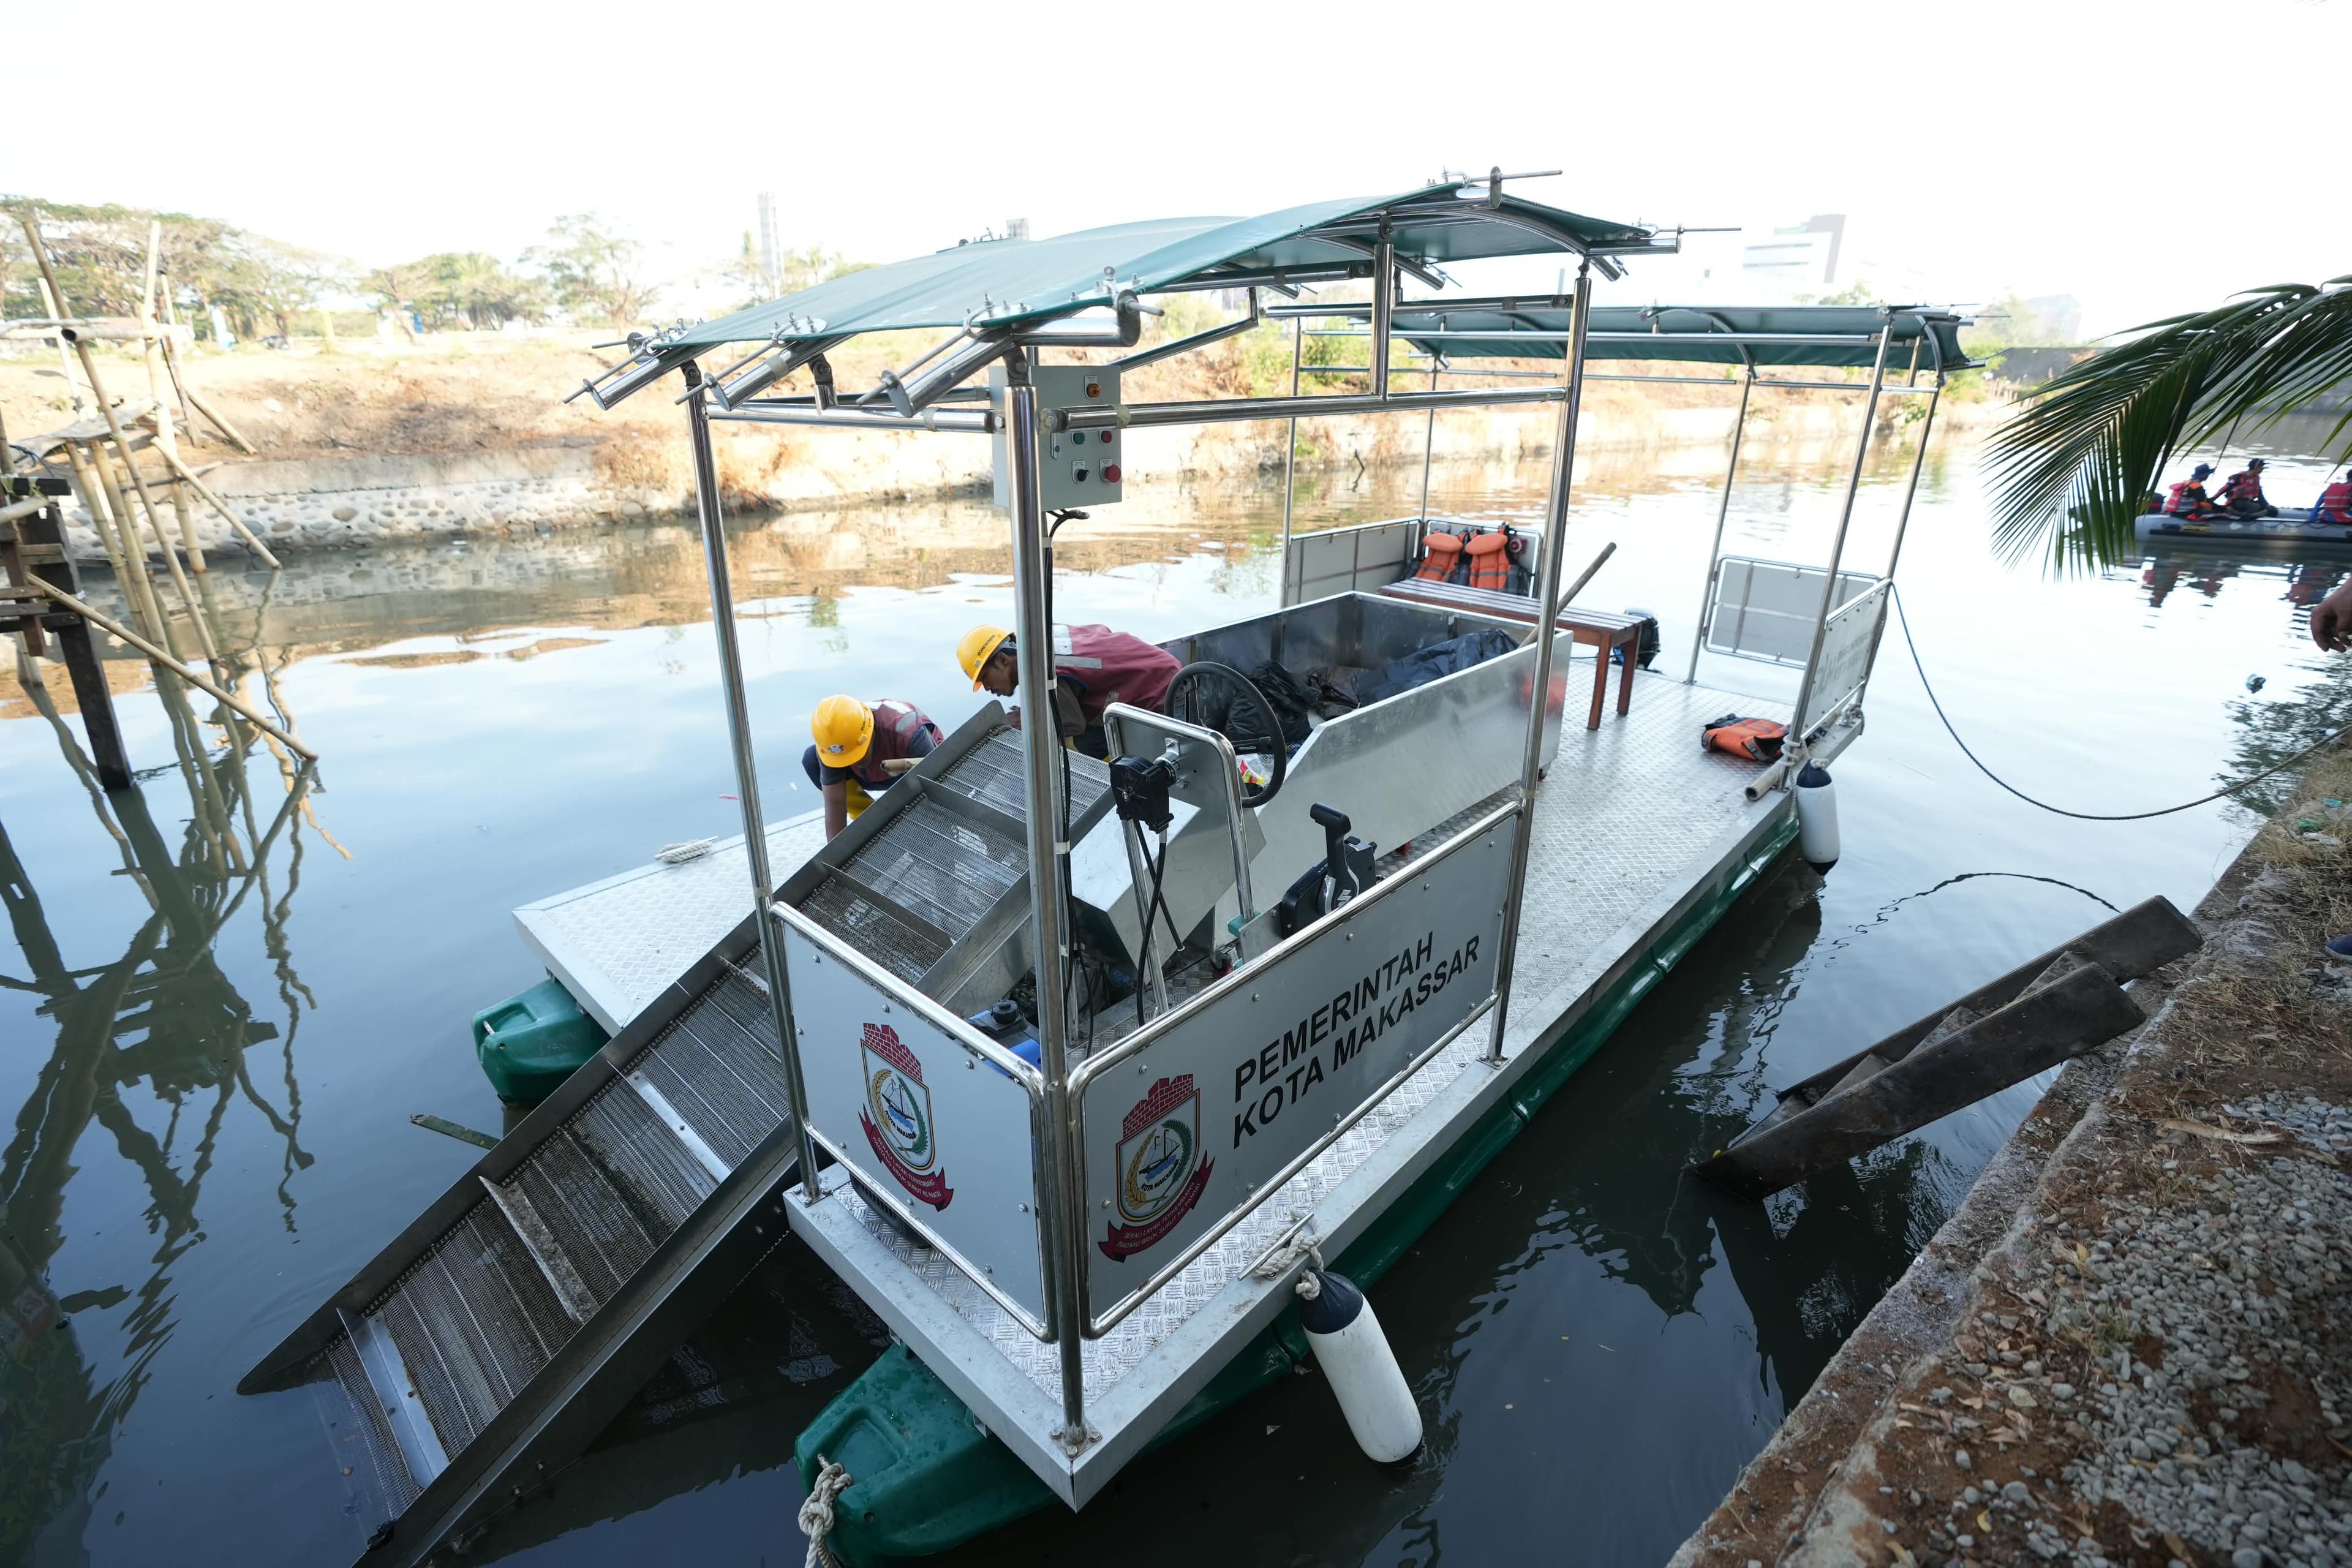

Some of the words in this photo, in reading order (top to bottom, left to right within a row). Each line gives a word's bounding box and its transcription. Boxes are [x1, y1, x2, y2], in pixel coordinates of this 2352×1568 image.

[1234, 1056, 1324, 1148] KOTA
[1333, 935, 1480, 1071] MAKASSAR
[1235, 931, 1433, 1103] PEMERINTAH
[873, 1137, 892, 1167] PANTANG
[877, 1137, 892, 1159] SEKALI
[892, 1159, 908, 1176] LAYAR
[1117, 1240, 1140, 1249] PANTANG
[1141, 1232, 1158, 1245] BIDUK
[1159, 1216, 1177, 1234] SURUT
[1177, 1207, 1185, 1216] KE
[1185, 1183, 1200, 1207] PANTAI
[1143, 1222, 1161, 1235] LAYAR
[1162, 1182, 1194, 1223] TERKEMBANG
